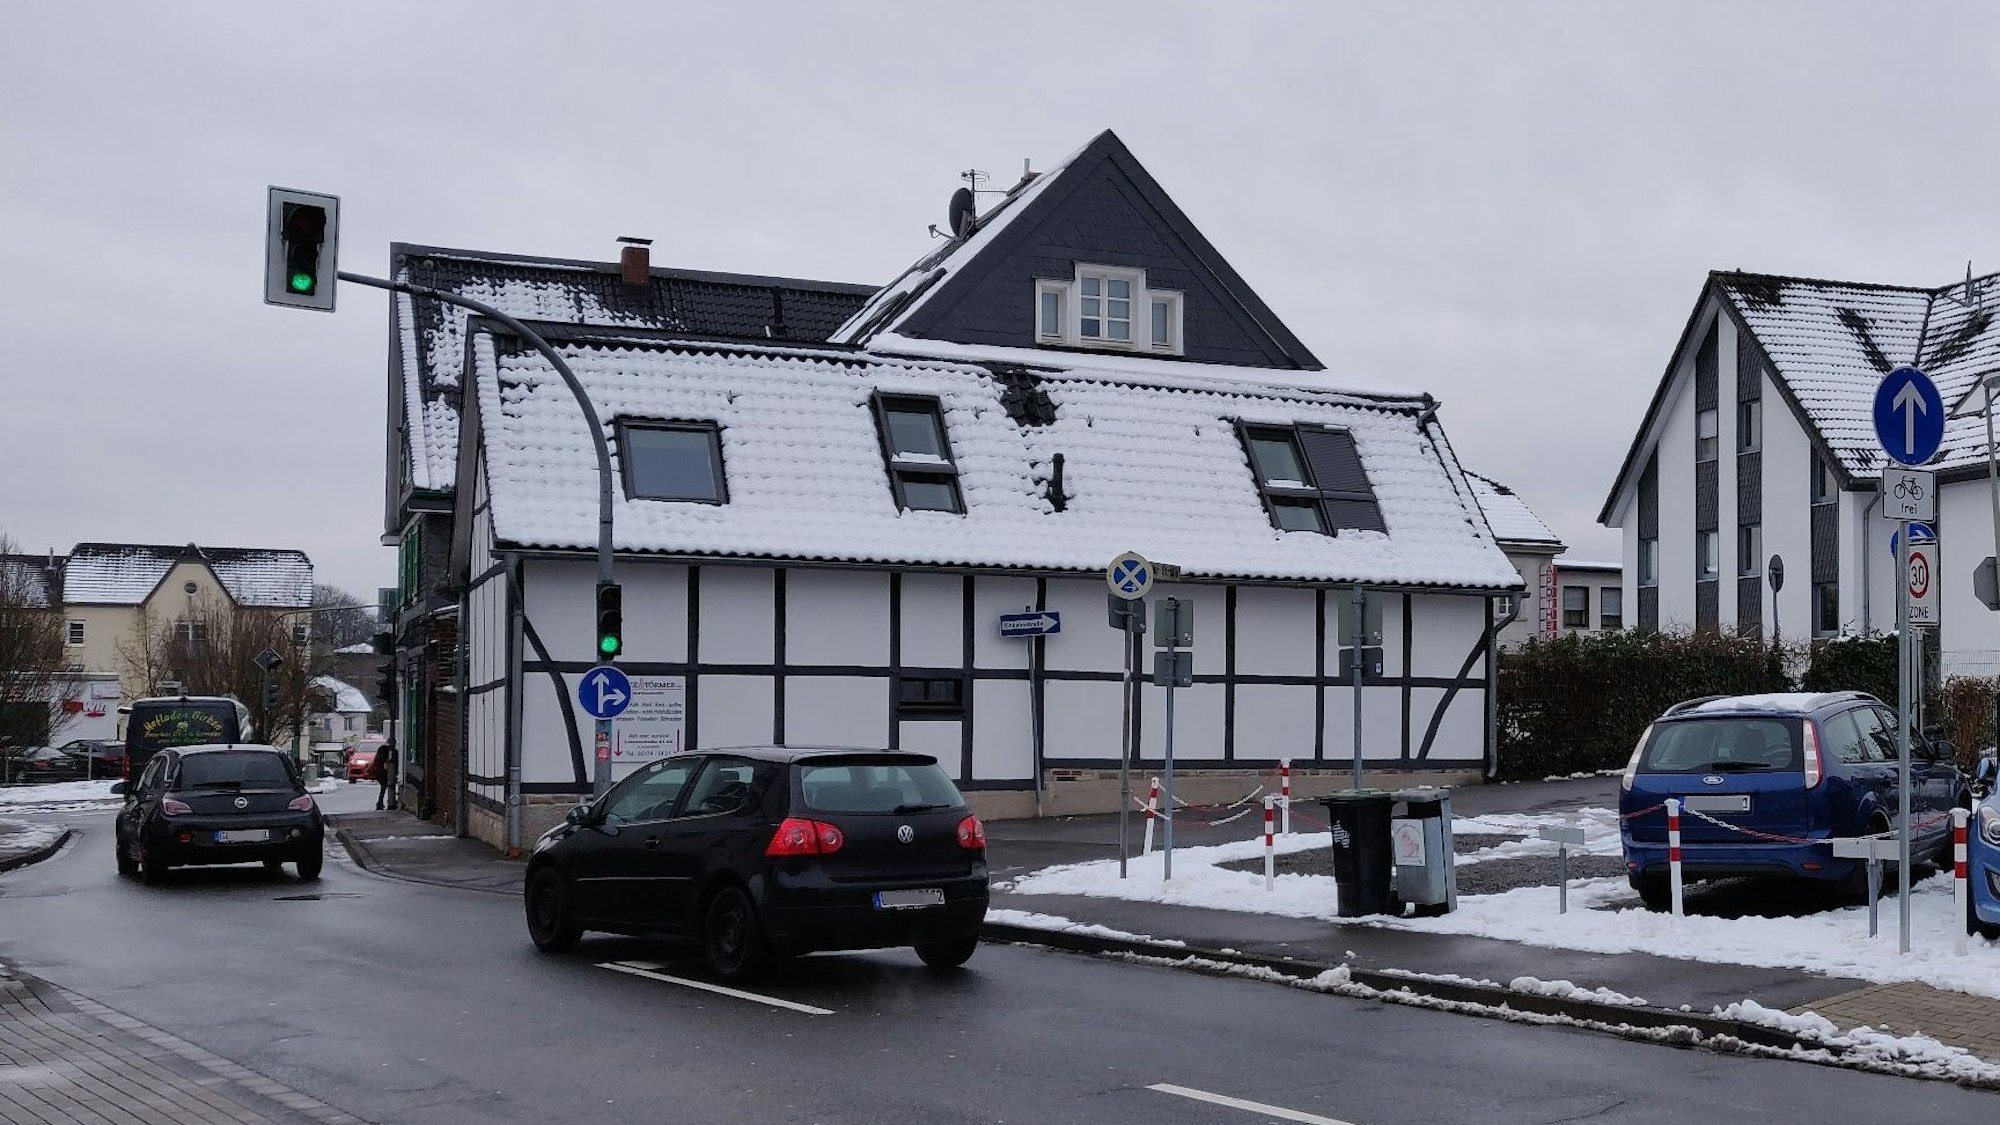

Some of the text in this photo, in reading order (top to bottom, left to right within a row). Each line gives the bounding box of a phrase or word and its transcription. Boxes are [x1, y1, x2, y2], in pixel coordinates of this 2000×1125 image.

[1901, 503, 1918, 515] frei
[1911, 564, 1925, 586] 30
[1909, 605, 1929, 619] ZONE
